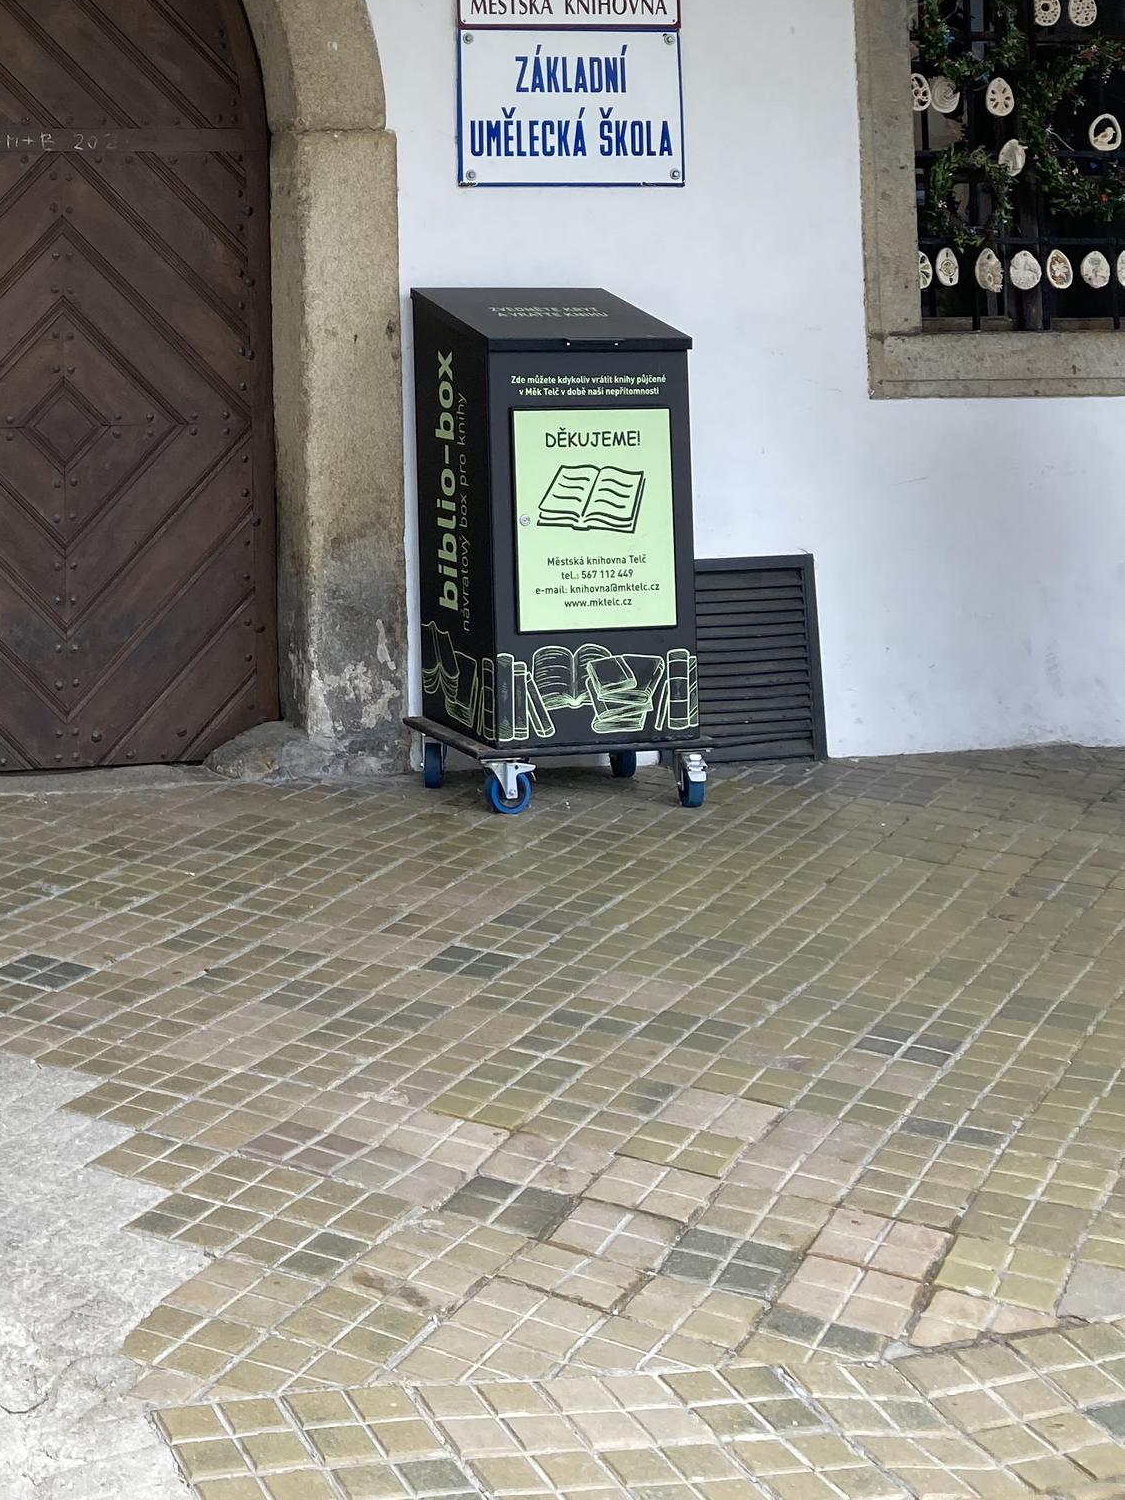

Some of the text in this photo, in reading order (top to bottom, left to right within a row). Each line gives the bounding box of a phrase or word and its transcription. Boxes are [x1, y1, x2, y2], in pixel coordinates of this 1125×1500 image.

[515, 44, 627, 93] ZÁKLADNÍ
[470, 107, 673, 157] UMĚLECKÁ ŠKOLA
[511, 374, 666, 385] Zde můžete kdykoliv vrátit knihy půjčené
[525, 387, 542, 396] Měk
[543, 387, 560, 396] Telč
[567, 387, 586, 396] době
[606, 386, 659, 397] nepřítomnosti
[545, 427, 641, 448] DĚKUJEME!
[435, 350, 459, 611] biblio-box
[456, 392, 471, 632] návratový box pro knihy
[547, 553, 647, 566] Městská knihovna Telč
[561, 568, 633, 580] tel.: 567 112 449
[535, 582, 660, 594] e-mail: knihovna@mktelc.cz
[564, 597, 632, 608] www.mktelc.cz
